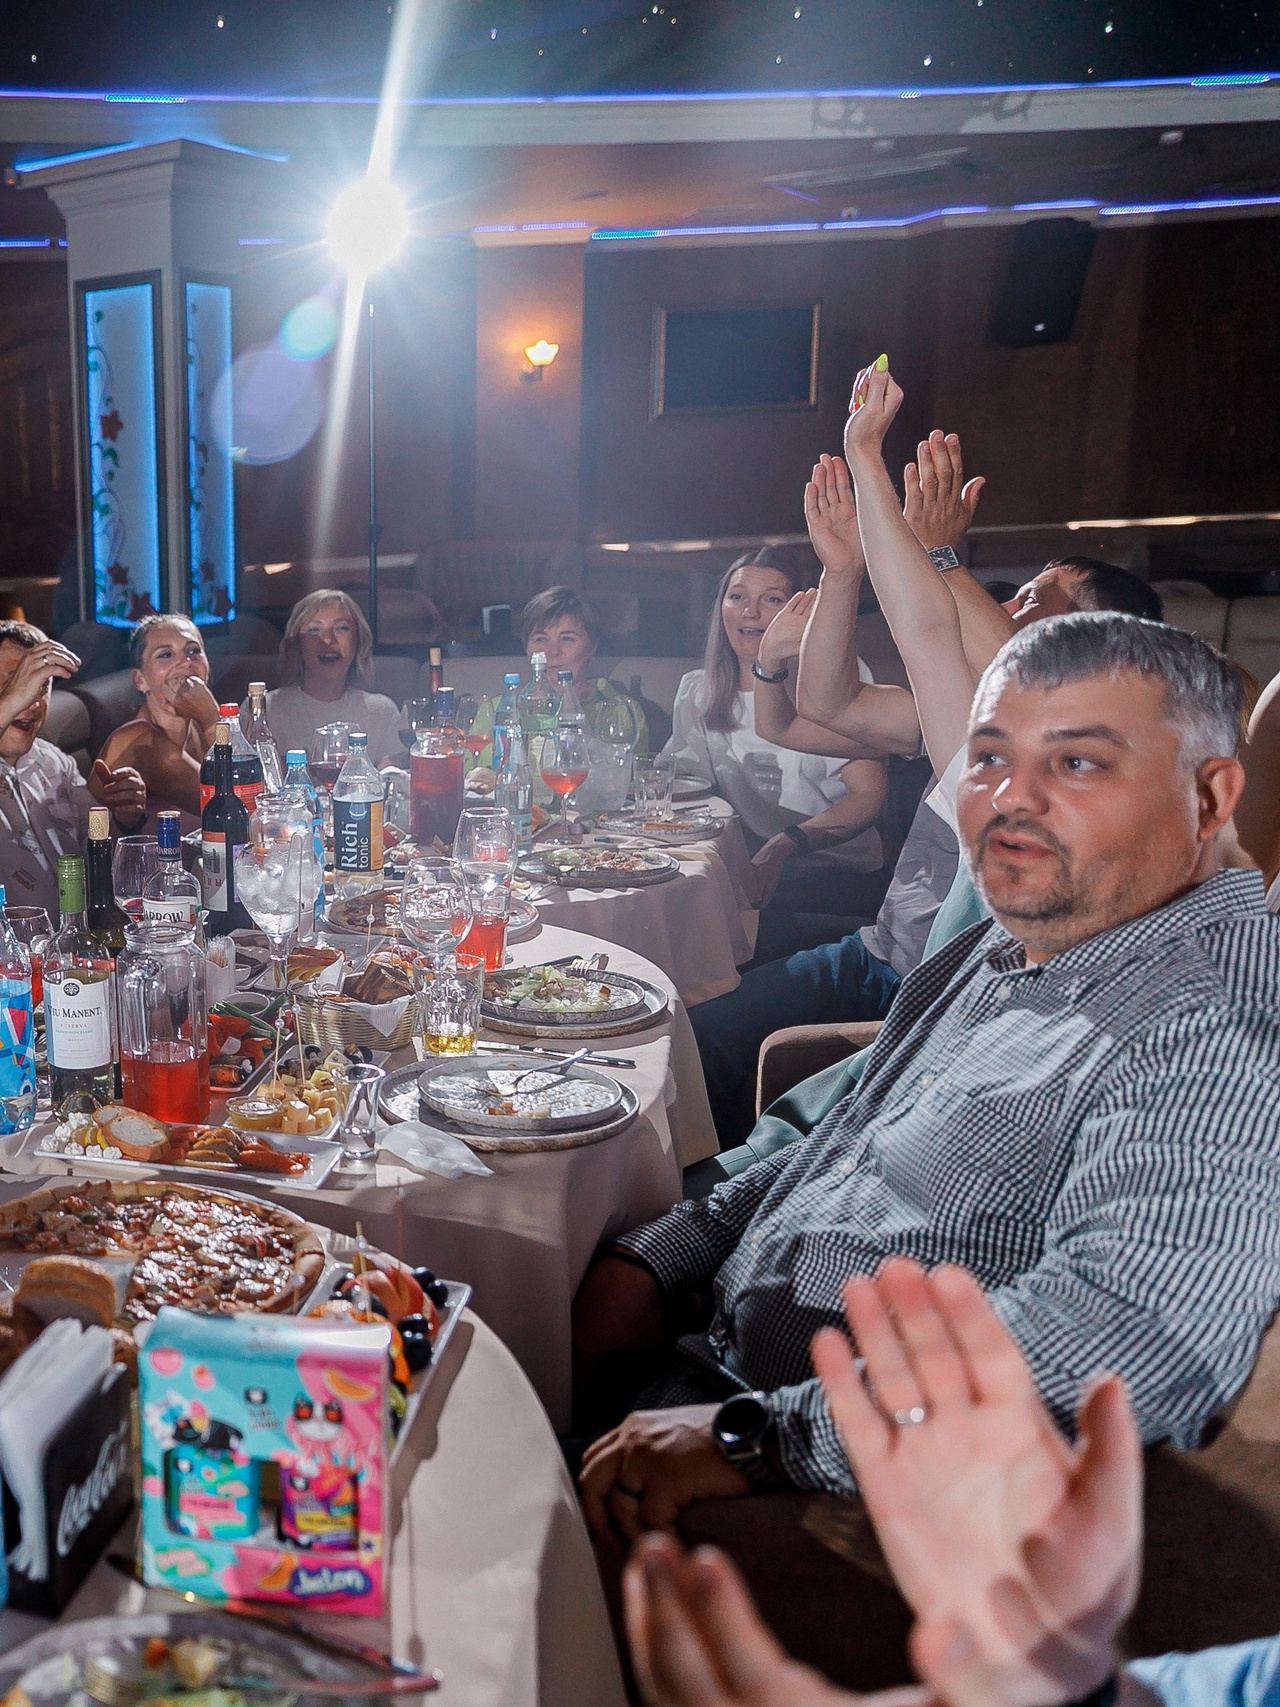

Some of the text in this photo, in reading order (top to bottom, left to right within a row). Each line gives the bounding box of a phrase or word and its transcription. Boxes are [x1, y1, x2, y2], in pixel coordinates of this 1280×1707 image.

[341, 822, 358, 868] Rich
[358, 837, 369, 869] tonic
[47, 1004, 61, 1017] VIU
